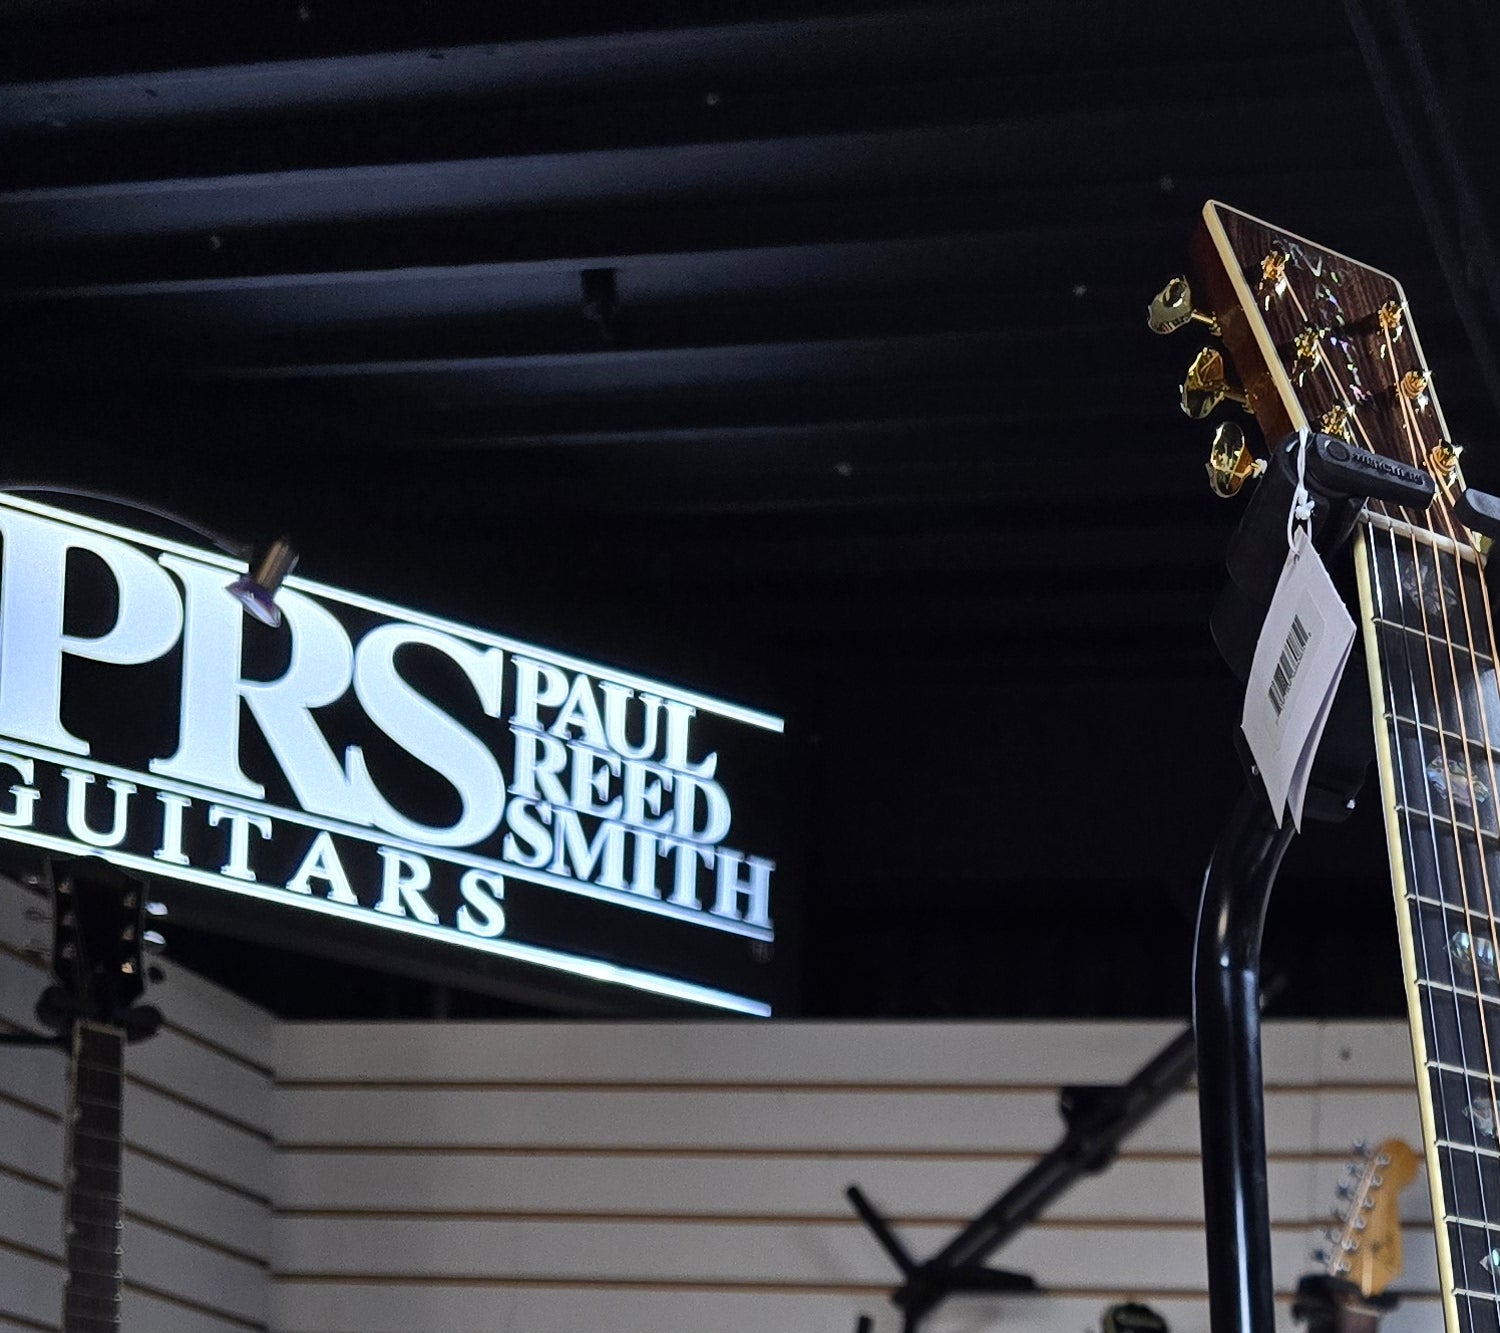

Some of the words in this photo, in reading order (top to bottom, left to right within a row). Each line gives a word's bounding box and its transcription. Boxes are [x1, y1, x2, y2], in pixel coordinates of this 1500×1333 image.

[0, 506, 505, 847] PRS
[509, 655, 717, 779] PAUL
[0, 752, 506, 938] GUITARS
[508, 725, 732, 844] REED
[503, 795, 776, 929] SMITH
